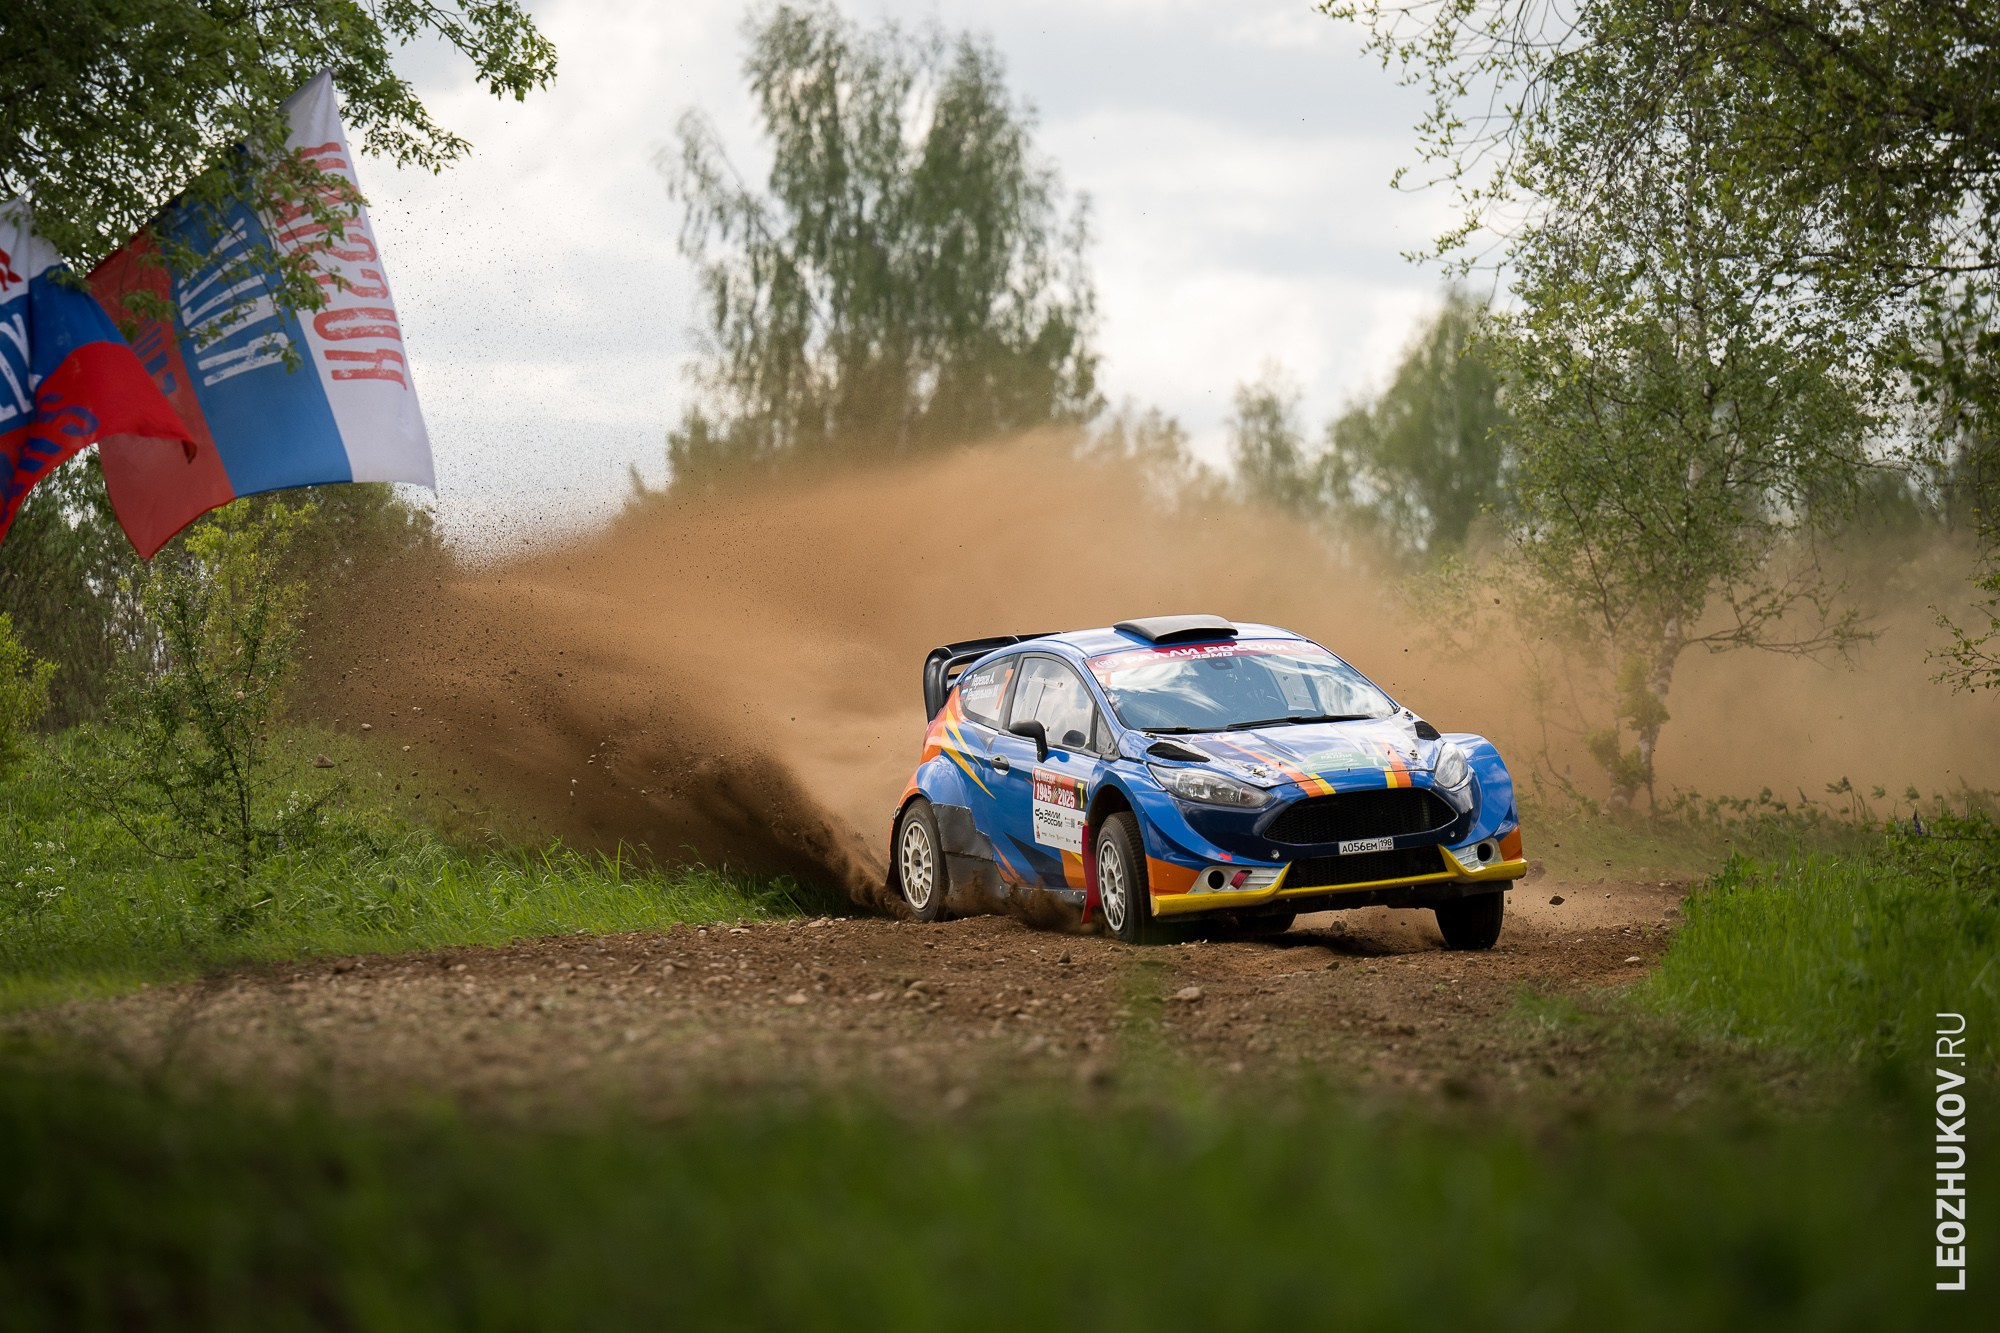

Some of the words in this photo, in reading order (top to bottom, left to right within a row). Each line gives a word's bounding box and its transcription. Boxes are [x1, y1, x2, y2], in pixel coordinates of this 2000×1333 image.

[1122, 647, 1199, 664] РАЛЛИ
[1203, 642, 1288, 655] РОССИИ
[1037, 782, 1051, 803] 1945
[1058, 788, 1075, 808] 2025
[1077, 782, 1084, 809] 7
[1379, 838, 1392, 847] 198
